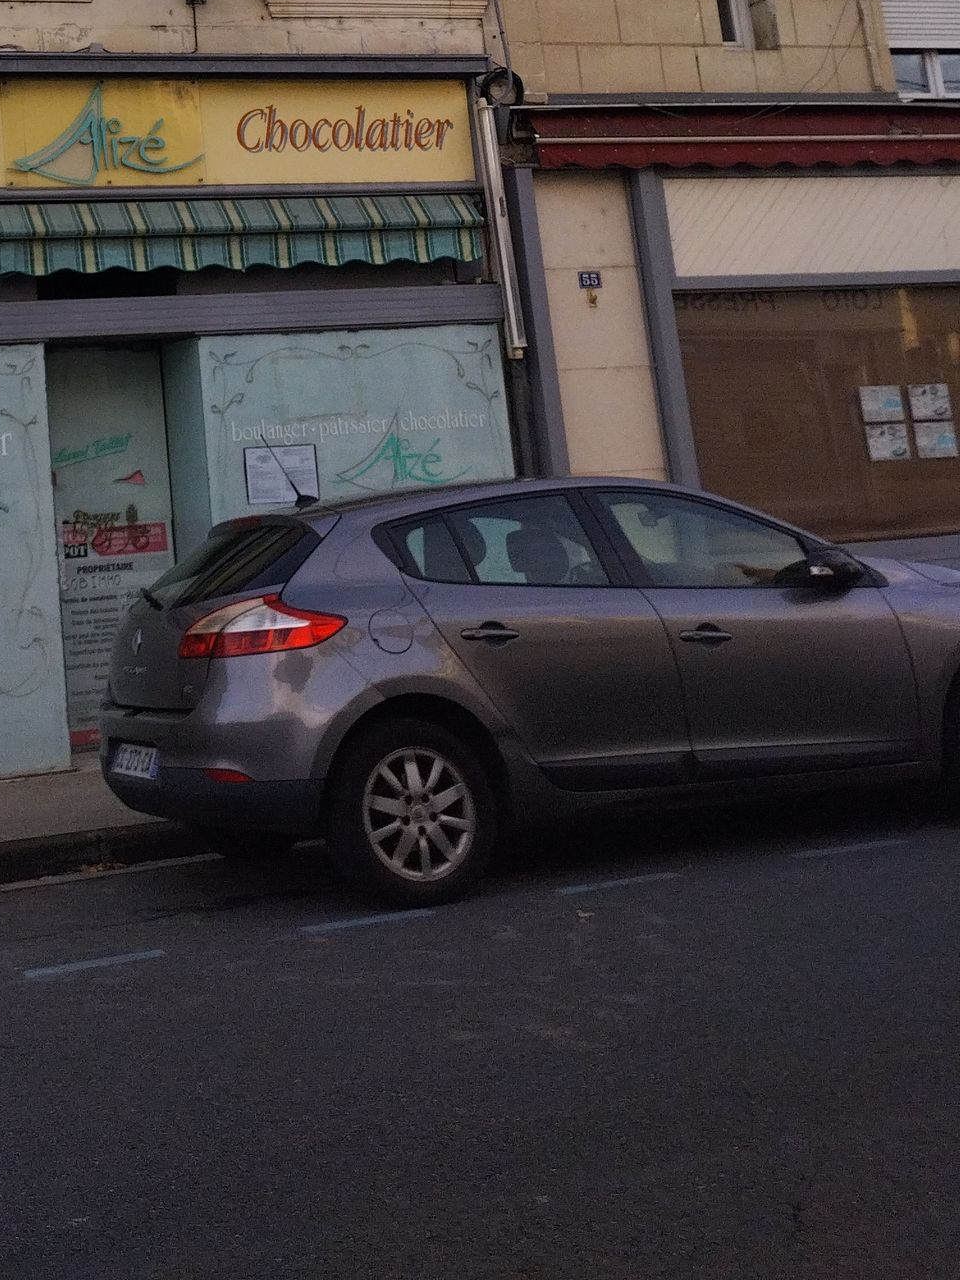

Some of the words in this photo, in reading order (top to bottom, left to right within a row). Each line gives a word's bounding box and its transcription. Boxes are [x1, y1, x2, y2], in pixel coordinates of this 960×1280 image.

[8, 82, 205, 185] Alizé
[236, 104, 454, 153] Chocolatier
[582, 273, 599, 286] 55
[231, 418, 311, 445] boulanger
[319, 416, 389, 442] pâtissier
[400, 409, 486, 432] chocolatier
